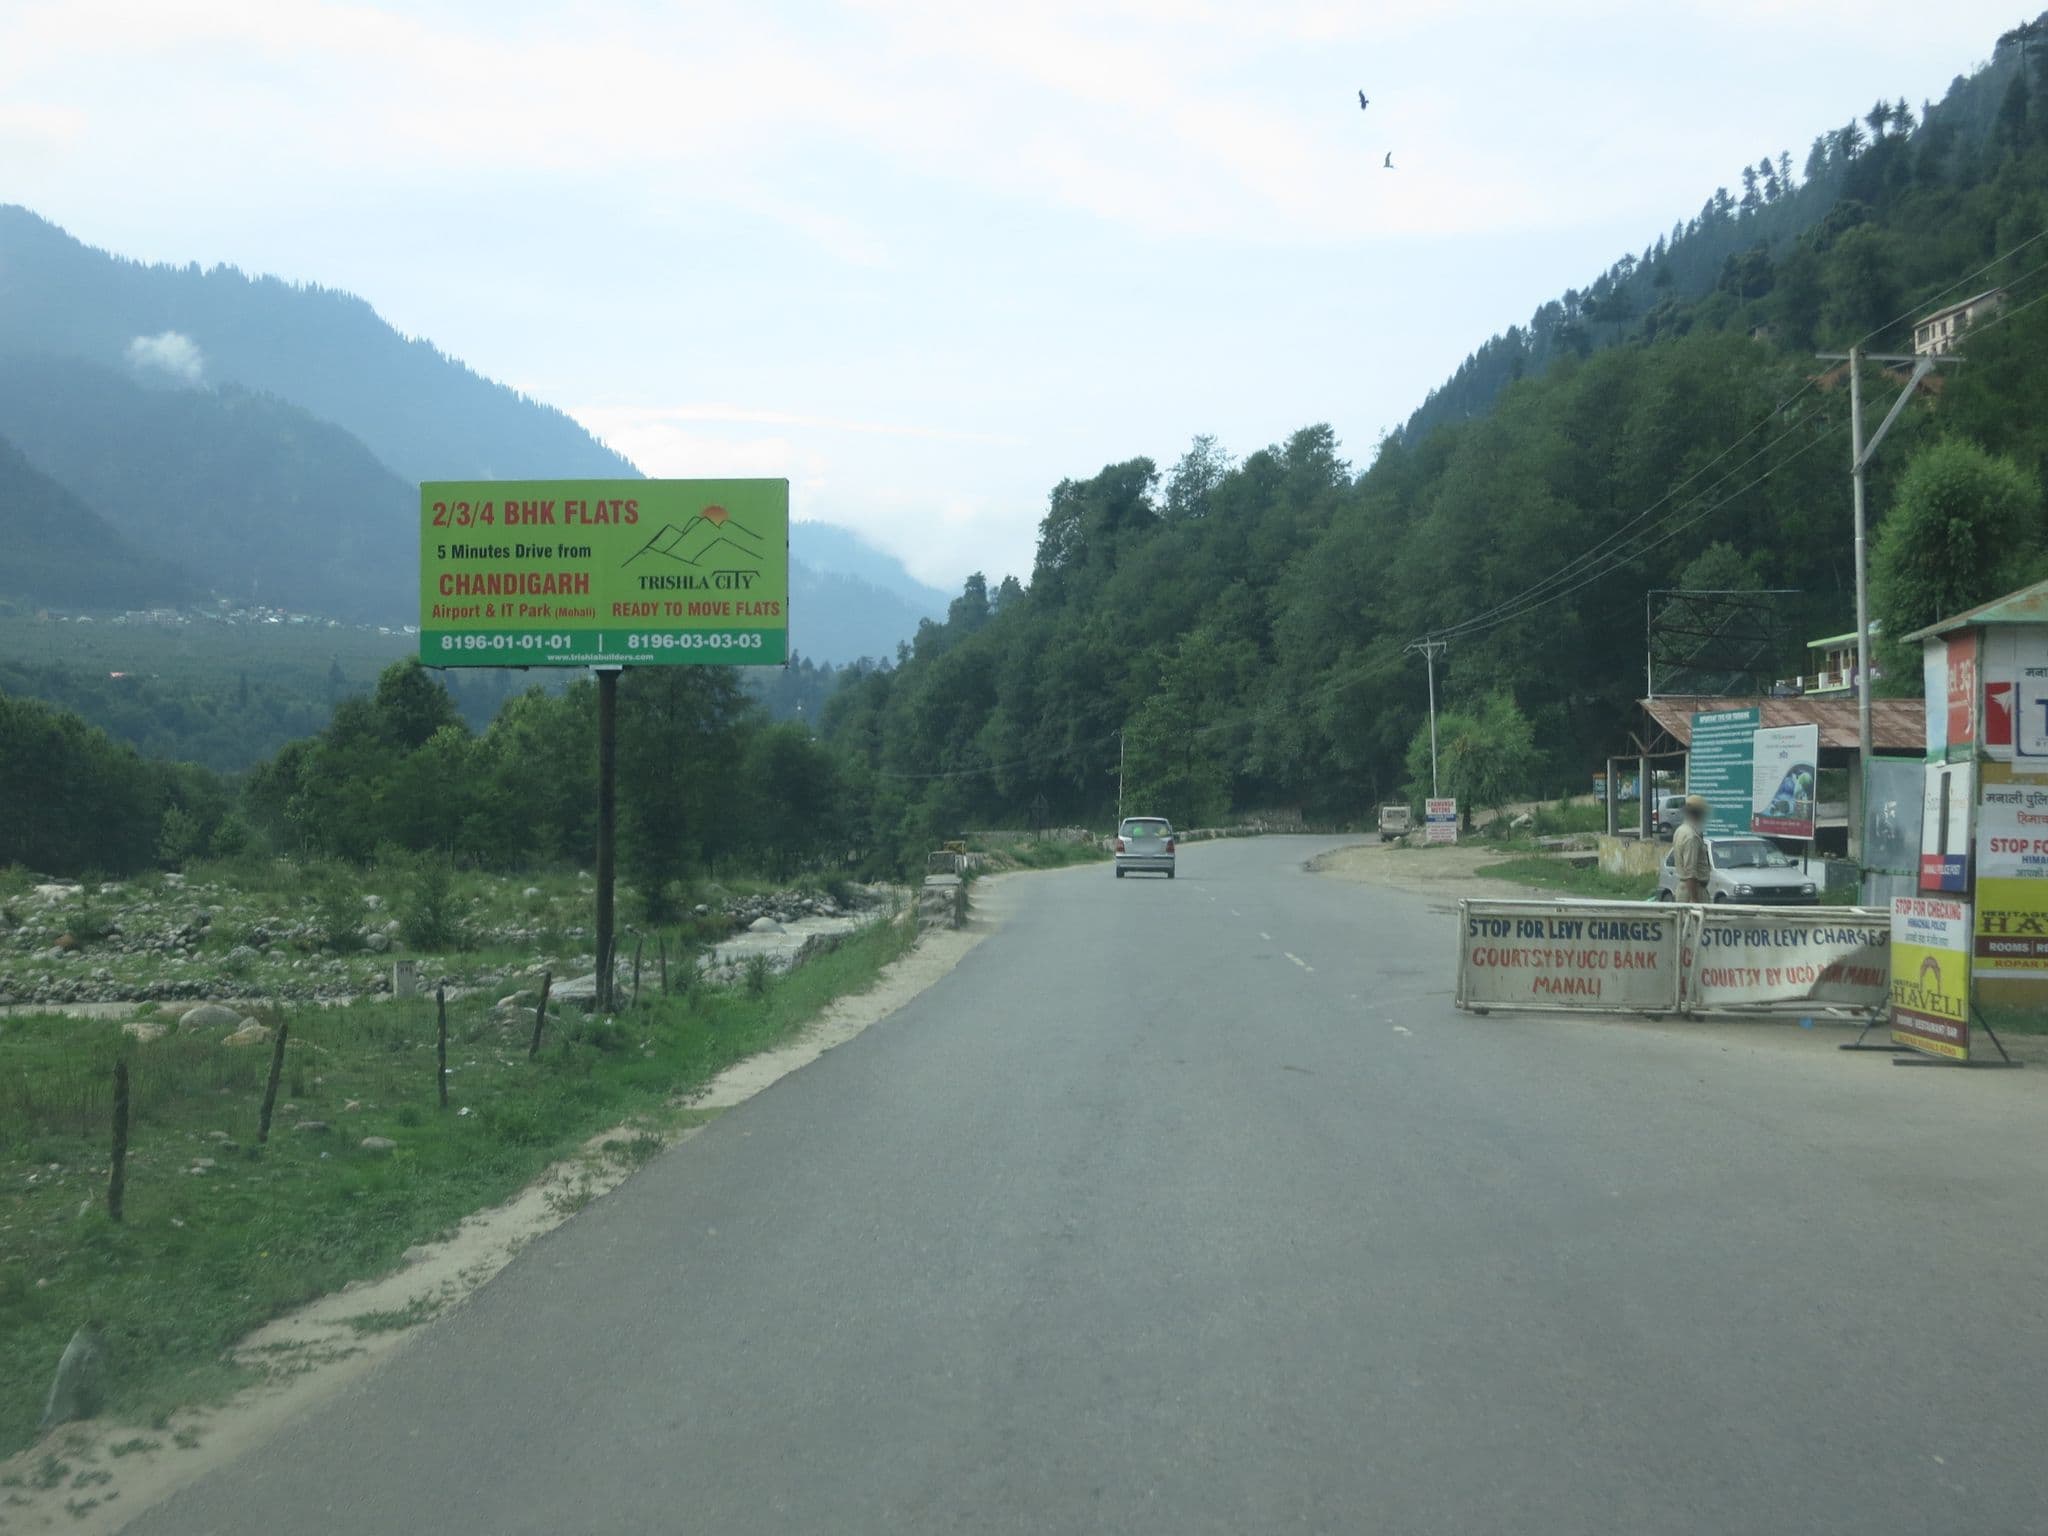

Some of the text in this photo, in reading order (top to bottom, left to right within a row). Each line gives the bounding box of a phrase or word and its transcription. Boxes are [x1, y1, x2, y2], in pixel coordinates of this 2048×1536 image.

[432, 499, 639, 528] 2/3/4 BHK FLATS
[437, 544, 592, 559] 5 Minutes Drive from
[439, 572, 590, 596] CHANDIGARH
[638, 570, 760, 590] TRISHLA CITY
[432, 604, 480, 621] Airport
[486, 603, 495, 617] &
[501, 603, 514, 617] IT
[519, 603, 551, 618] Park
[612, 601, 780, 617] READY TO MOVE FLATS
[441, 635, 572, 650] 8196-01-01-01
[628, 634, 762, 649] 8196-03-03-03
[1990, 838, 2029, 853] STOP
[2022, 855, 2048, 864] HIMA
[1896, 899, 1912, 915] STOP
[1469, 918, 1663, 942] STOP FOR LEVY CHARGES
[1701, 928, 1742, 948] STOP
[1744, 928, 1771, 947] FOR
[1774, 928, 1808, 947] LEVY
[1813, 928, 1890, 947] CHARGES
[1989, 943, 2029, 952] ROOMS
[1472, 947, 1552, 968] COURTSY
[1555, 950, 1575, 968] BY
[1614, 951, 1658, 969] BANK
[1532, 976, 1602, 996] MANALI
[1702, 966, 1761, 988] COURTSY
[1766, 968, 1781, 987] BY
[1786, 965, 1815, 985] UCO
[1893, 985, 1962, 1018] HAVELI
